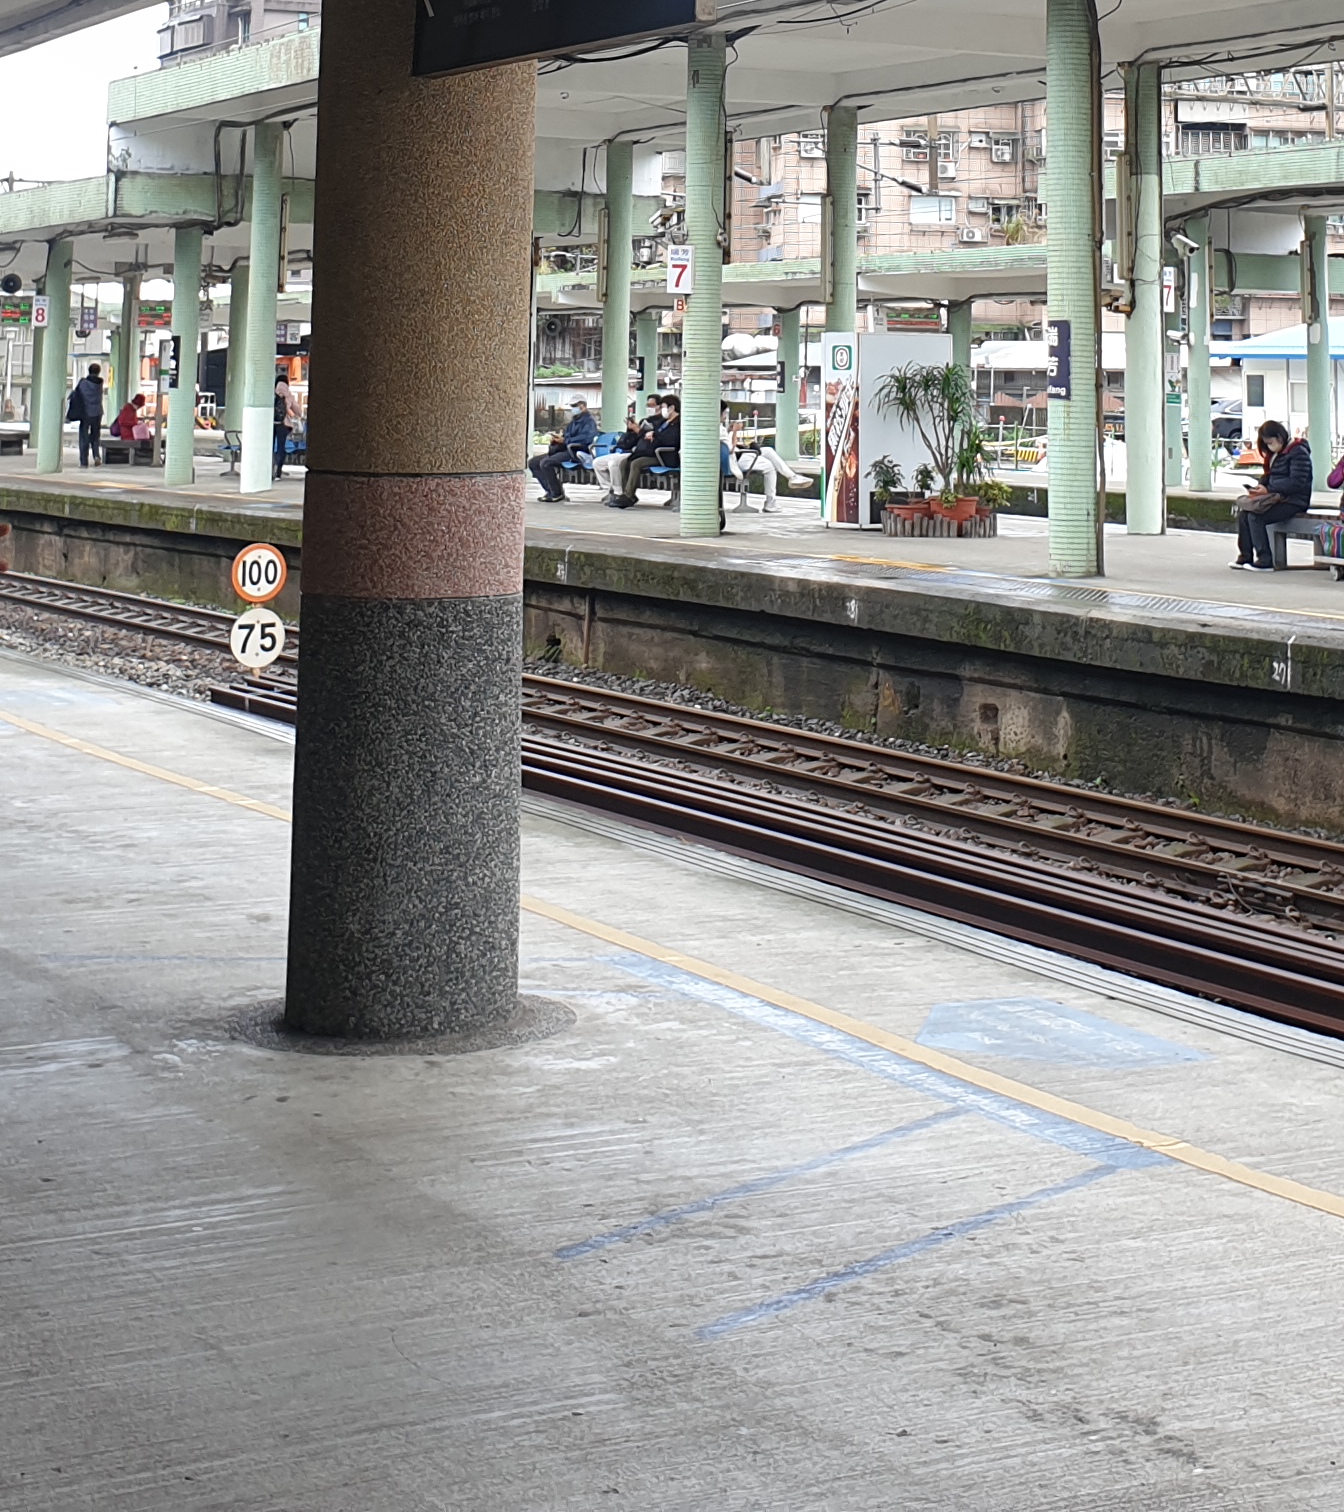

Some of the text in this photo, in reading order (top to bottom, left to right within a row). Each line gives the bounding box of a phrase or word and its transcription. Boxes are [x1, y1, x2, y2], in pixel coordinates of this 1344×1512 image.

[672, 264, 688, 288] 7
[36, 308, 45, 322] 8
[242, 559, 277, 587] 100
[238, 622, 277, 653] 75
[1271, 661, 1286, 685] 27
